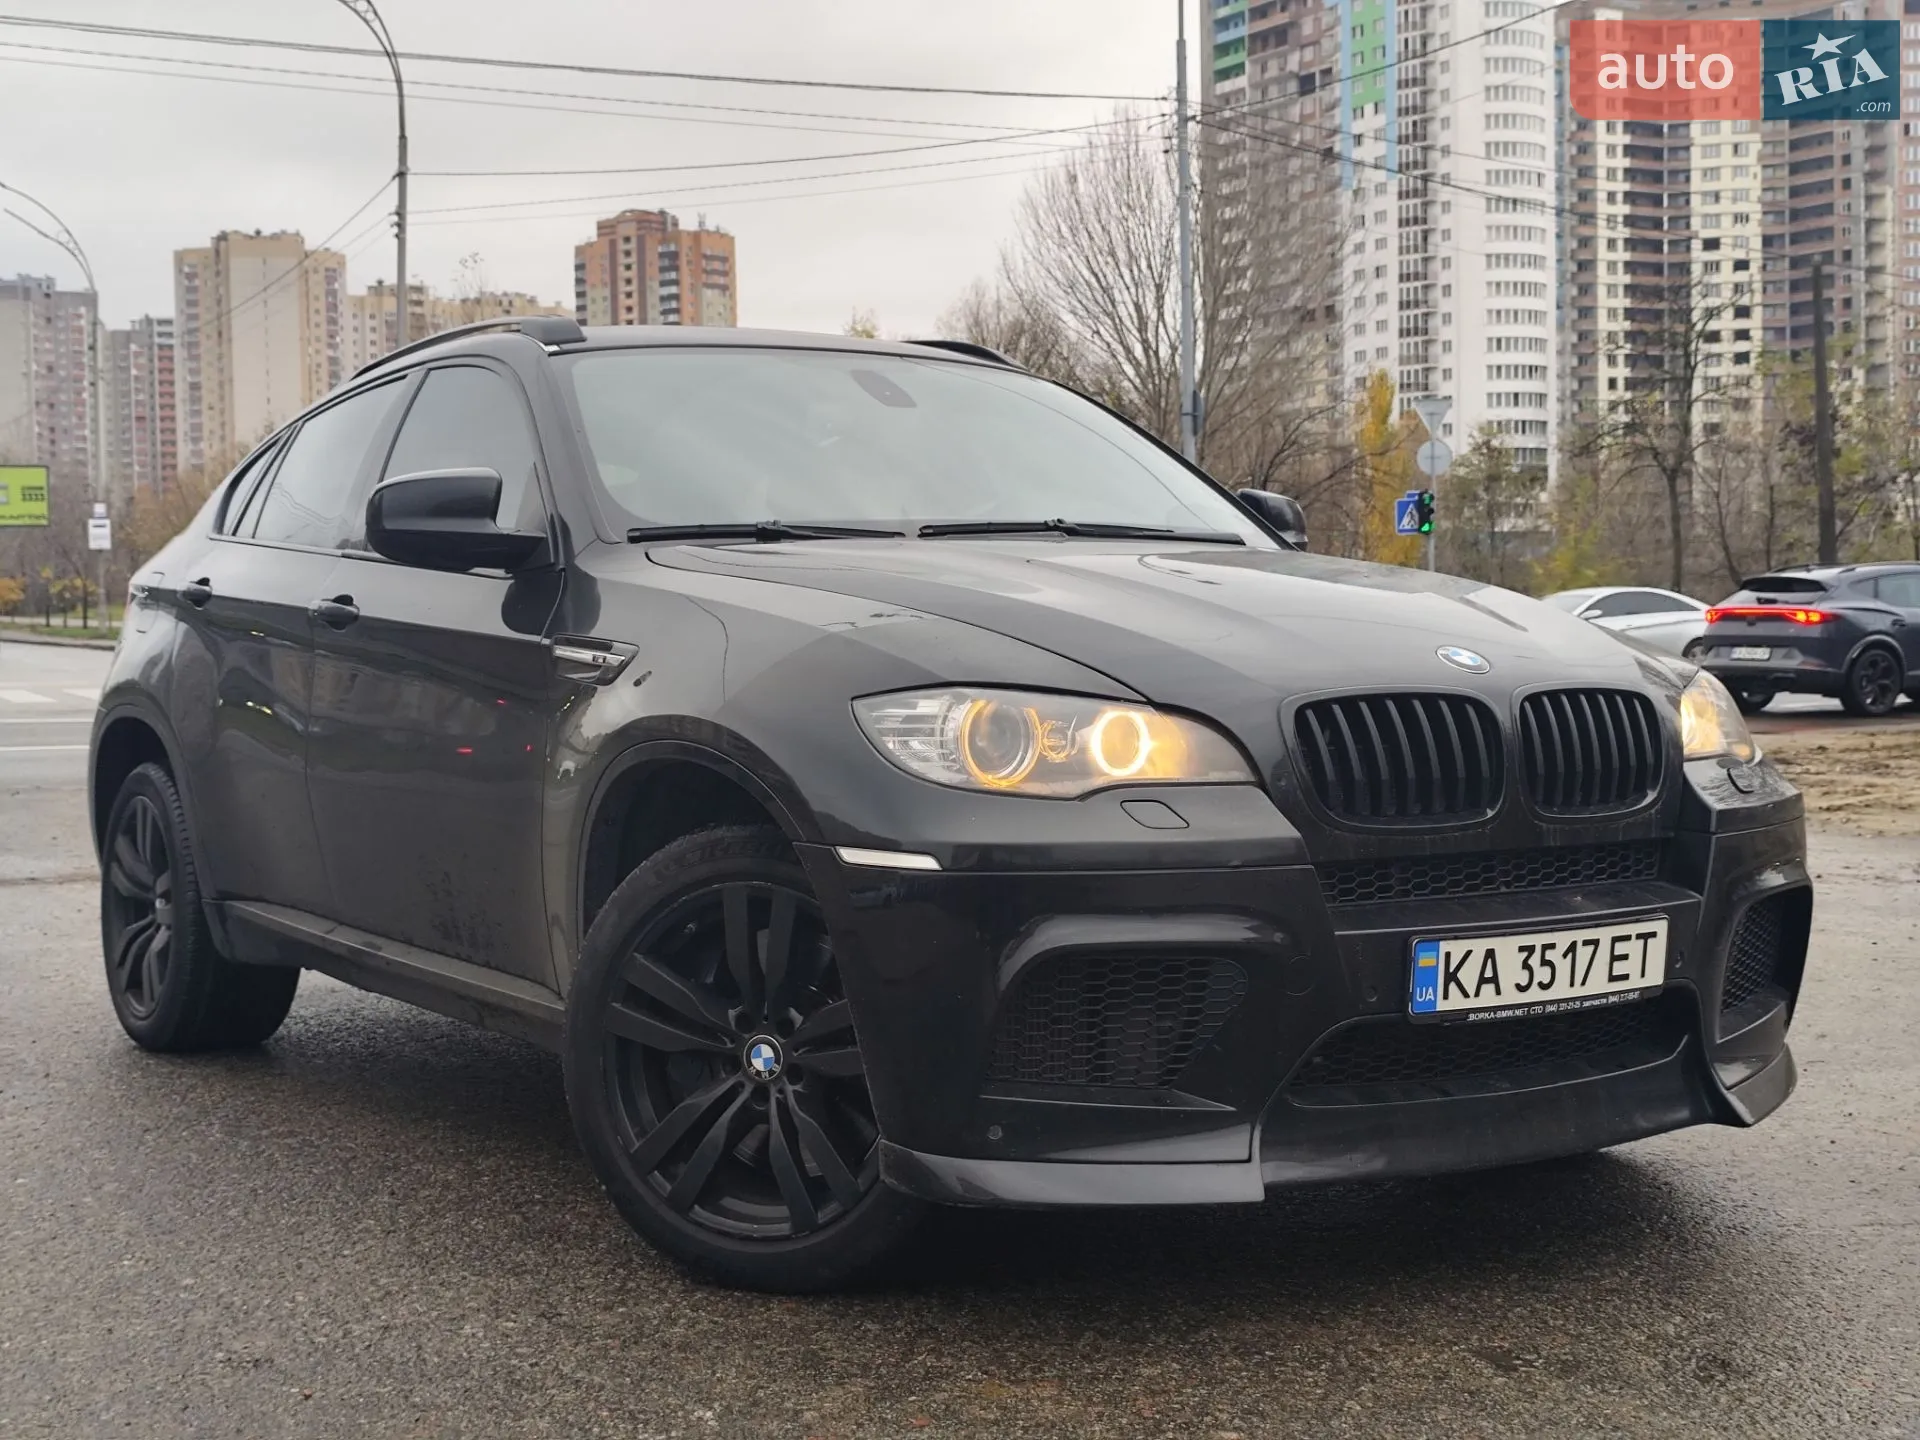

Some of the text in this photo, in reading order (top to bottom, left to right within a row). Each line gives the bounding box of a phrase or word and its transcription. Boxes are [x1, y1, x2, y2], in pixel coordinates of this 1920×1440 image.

[1442, 931, 1658, 1001] KA 3517 ET
[1416, 986, 1435, 1002] UA
